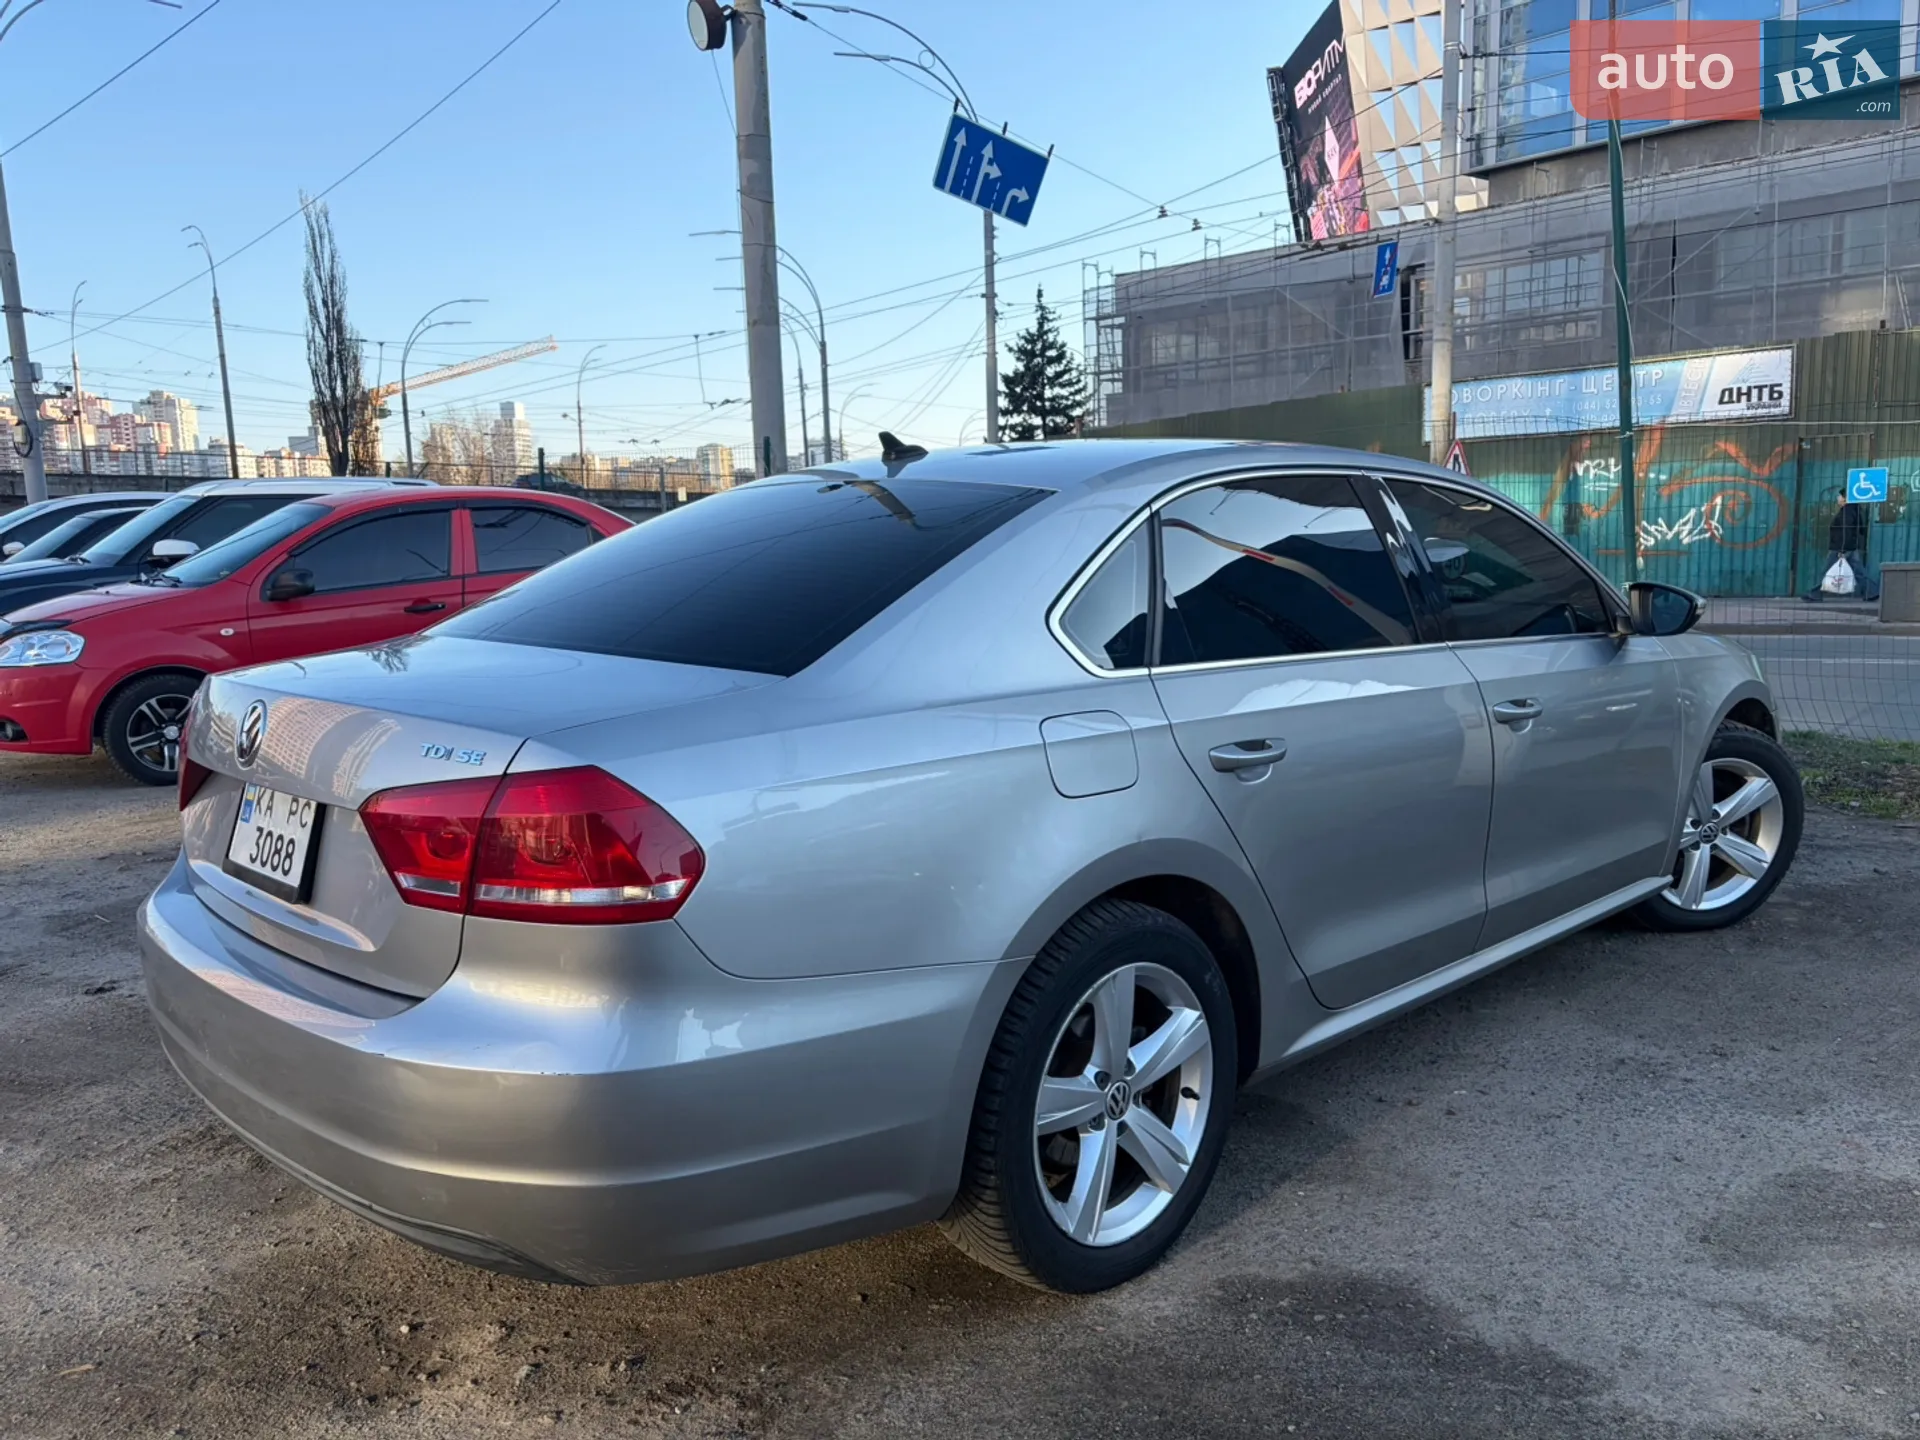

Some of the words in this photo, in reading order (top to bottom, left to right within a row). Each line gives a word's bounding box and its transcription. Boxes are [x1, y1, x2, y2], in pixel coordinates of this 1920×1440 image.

[1718, 383, 1784, 405] ДНТБ
[420, 743, 455, 761] TDI
[455, 749, 487, 767] SE
[287, 796, 312, 828] PC
[249, 825, 296, 876] 3088
